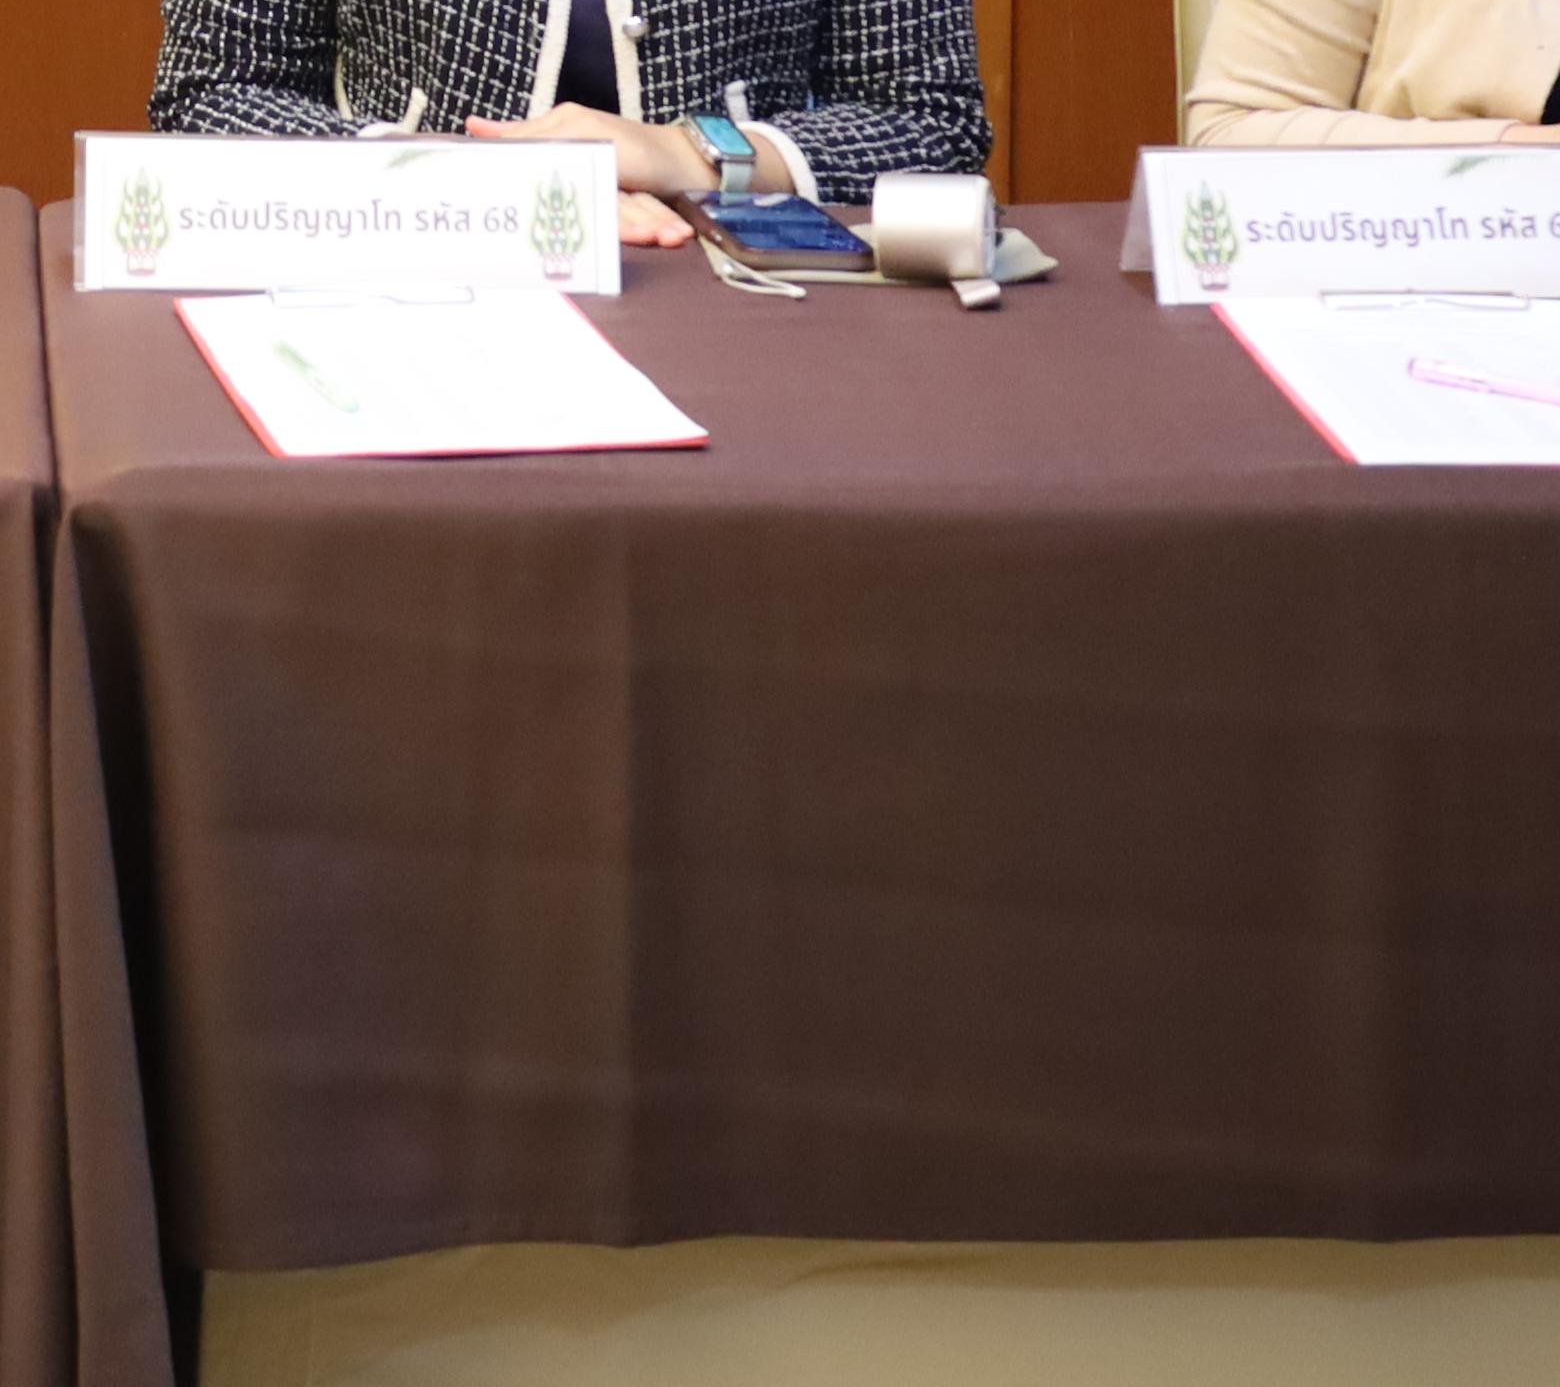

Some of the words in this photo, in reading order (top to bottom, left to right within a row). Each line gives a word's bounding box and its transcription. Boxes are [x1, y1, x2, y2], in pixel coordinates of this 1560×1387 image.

[179, 198, 401, 239] ระดับปริญญาโท
[415, 202, 470, 232] รหัส
[483, 206, 519, 233] 68
[1246, 206, 1470, 249] ระดับปริญญาโท
[1480, 207, 1539, 240] รหัส
